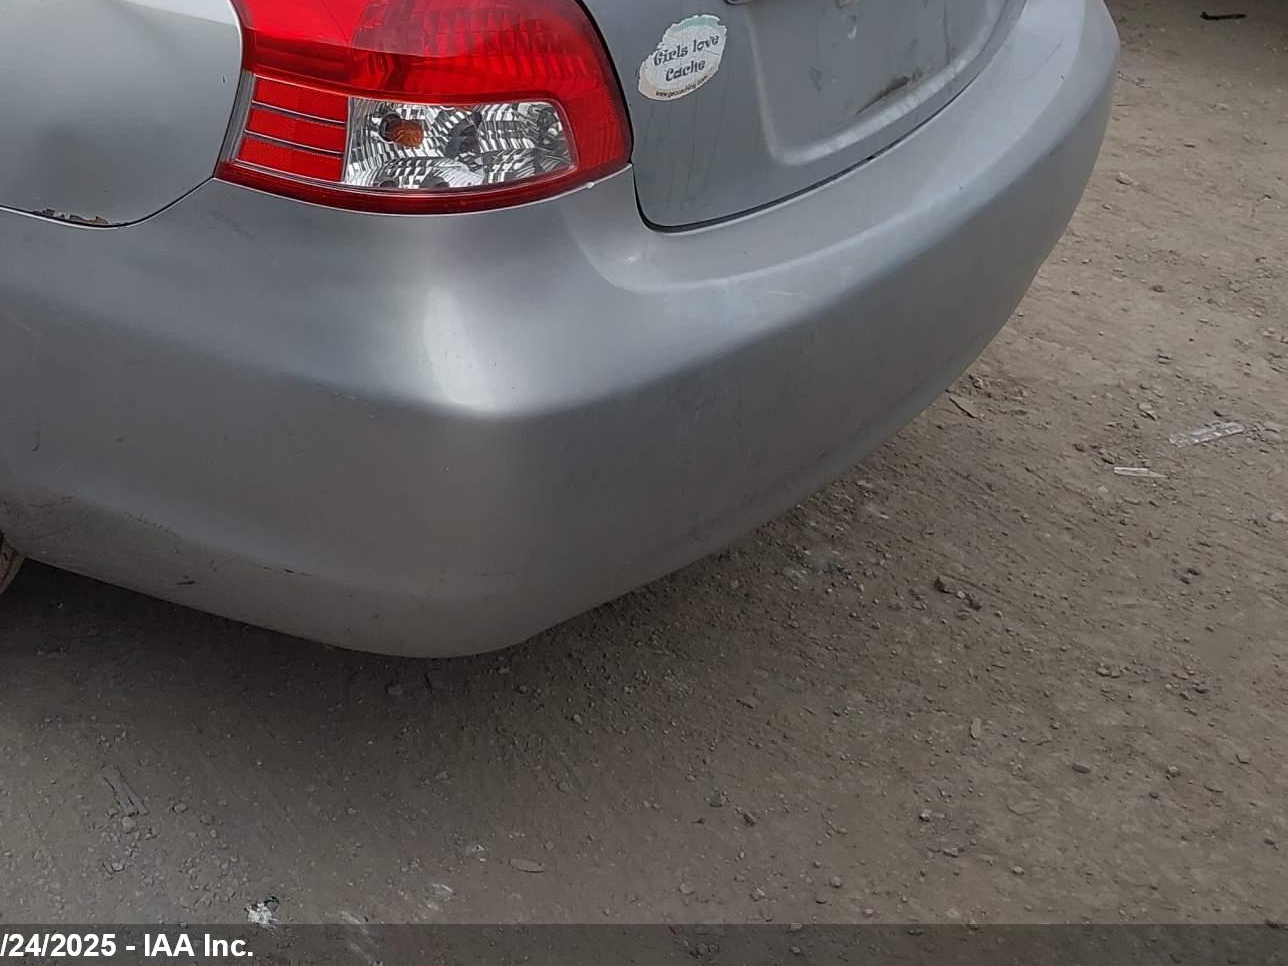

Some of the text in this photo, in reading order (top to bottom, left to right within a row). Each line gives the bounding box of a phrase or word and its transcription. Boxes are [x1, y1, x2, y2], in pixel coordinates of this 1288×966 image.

[653, 34, 720, 66] Girls love
[665, 60, 706, 82] Cache
